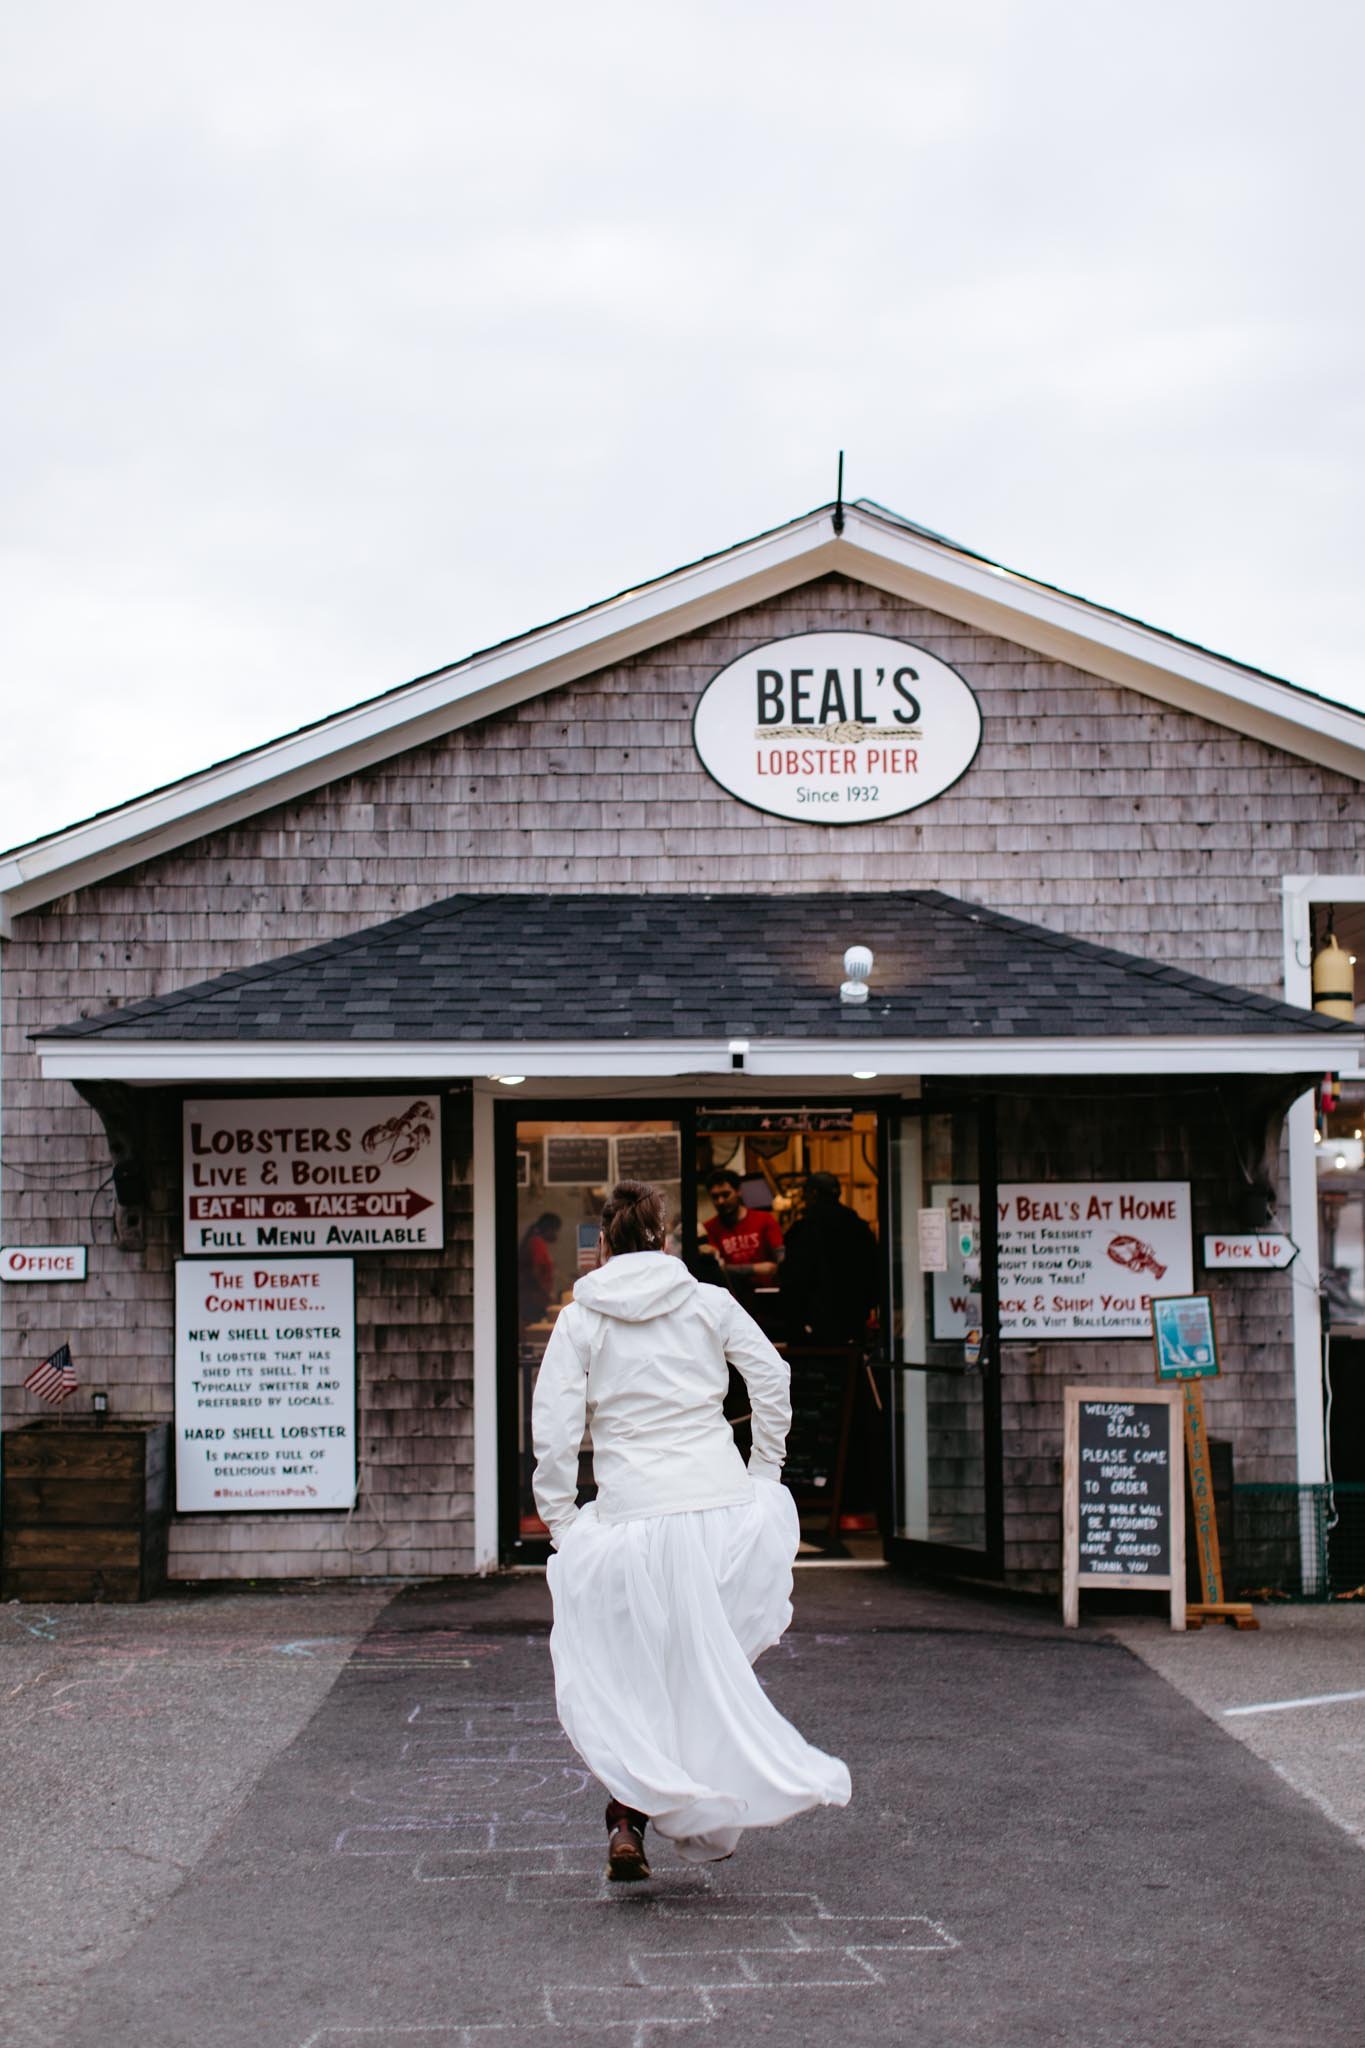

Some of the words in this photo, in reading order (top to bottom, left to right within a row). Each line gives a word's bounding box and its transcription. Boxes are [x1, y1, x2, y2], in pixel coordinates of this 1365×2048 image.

[756, 667, 921, 725] BEAL'S
[757, 749, 857, 775] LOBSTER
[867, 748, 918, 773] PIER
[796, 787, 840, 802] Since
[847, 786, 879, 802] 1932
[191, 1123, 352, 1154] LOBSTERS
[192, 1163, 247, 1187] LIVE
[261, 1160, 278, 1185] &
[292, 1161, 381, 1184] BOILED
[197, 1197, 264, 1218] EAT-IN
[272, 1201, 297, 1216] OR
[305, 1194, 411, 1215] TAKE-OUT
[1016, 1196, 1080, 1221] BEAL'S
[1087, 1195, 1113, 1220] AT
[1120, 1195, 1176, 1220] HOME
[201, 1228, 245, 1247] FULL
[257, 1227, 315, 1245] MENU
[326, 1226, 427, 1244] AVAILABLE
[1017, 1231, 1036, 1240] THE
[1032, 1244, 1079, 1254] LOBSTER
[1214, 1241, 1252, 1258] PICK
[1258, 1241, 1281, 1257] UP
[9, 1253, 75, 1271] OFFICE
[1032, 1260, 1062, 1269] FROM
[210, 1272, 244, 1288] THE
[254, 1271, 320, 1288] DEBATE
[205, 1295, 325, 1312] CONTINUES...
[1033, 1295, 1045, 1311] &
[1052, 1295, 1093, 1312] SHIP!
[1100, 1295, 1136, 1311] YOU
[188, 1330, 220, 1341] NEW
[228, 1328, 269, 1341] SHELL
[276, 1327, 341, 1339] LOBSTER
[200, 1351, 211, 1362] IS
[217, 1352, 267, 1362] LOBSTER
[274, 1351, 302, 1361] THAT
[308, 1351, 331, 1360] HAS
[202, 1366, 231, 1377] SHED
[236, 1367, 253, 1376] ITS
[301, 1364, 313, 1375] IT
[319, 1365, 331, 1375] IS
[192, 1381, 252, 1393] TYPICALLY
[259, 1381, 309, 1391] SWEETER
[316, 1380, 340, 1390] AND
[197, 1397, 262, 1408] PREFERRED
[268, 1397, 282, 1406] BY
[1085, 1404, 1135, 1416] WELCOME
[1110, 1414, 1125, 1424] TO
[184, 1428, 225, 1440] HARD
[232, 1427, 274, 1440] SHELL
[281, 1426, 347, 1439] LOBSTER
[1107, 1422, 1151, 1438] BEAL'S
[206, 1449, 218, 1462] IS
[223, 1451, 269, 1461] PACKED
[275, 1450, 302, 1460] FULL
[310, 1449, 326, 1459] OF
[1082, 1448, 1127, 1463] PLEASE
[1133, 1450, 1167, 1464] COME
[214, 1466, 276, 1477] DELICIOUS
[1101, 1465, 1136, 1479] INSIDE
[1084, 1480, 1100, 1494] TO
[1110, 1481, 1148, 1495] ORDER
[1080, 1503, 1105, 1516] YOUR
[1108, 1504, 1137, 1515] TABLE
[1139, 1504, 1163, 1516] WILL
[1088, 1517, 1103, 1529] BE
[1109, 1516, 1158, 1530] ASSIGNED
[1087, 1531, 1112, 1542] ONCE
[1118, 1532, 1137, 1543] YOU
[1080, 1543, 1106, 1555] HAVE
[1114, 1544, 1161, 1556] ORDERED
[1090, 1561, 1123, 1572] THANK
[1127, 1561, 1148, 1572] YOU
